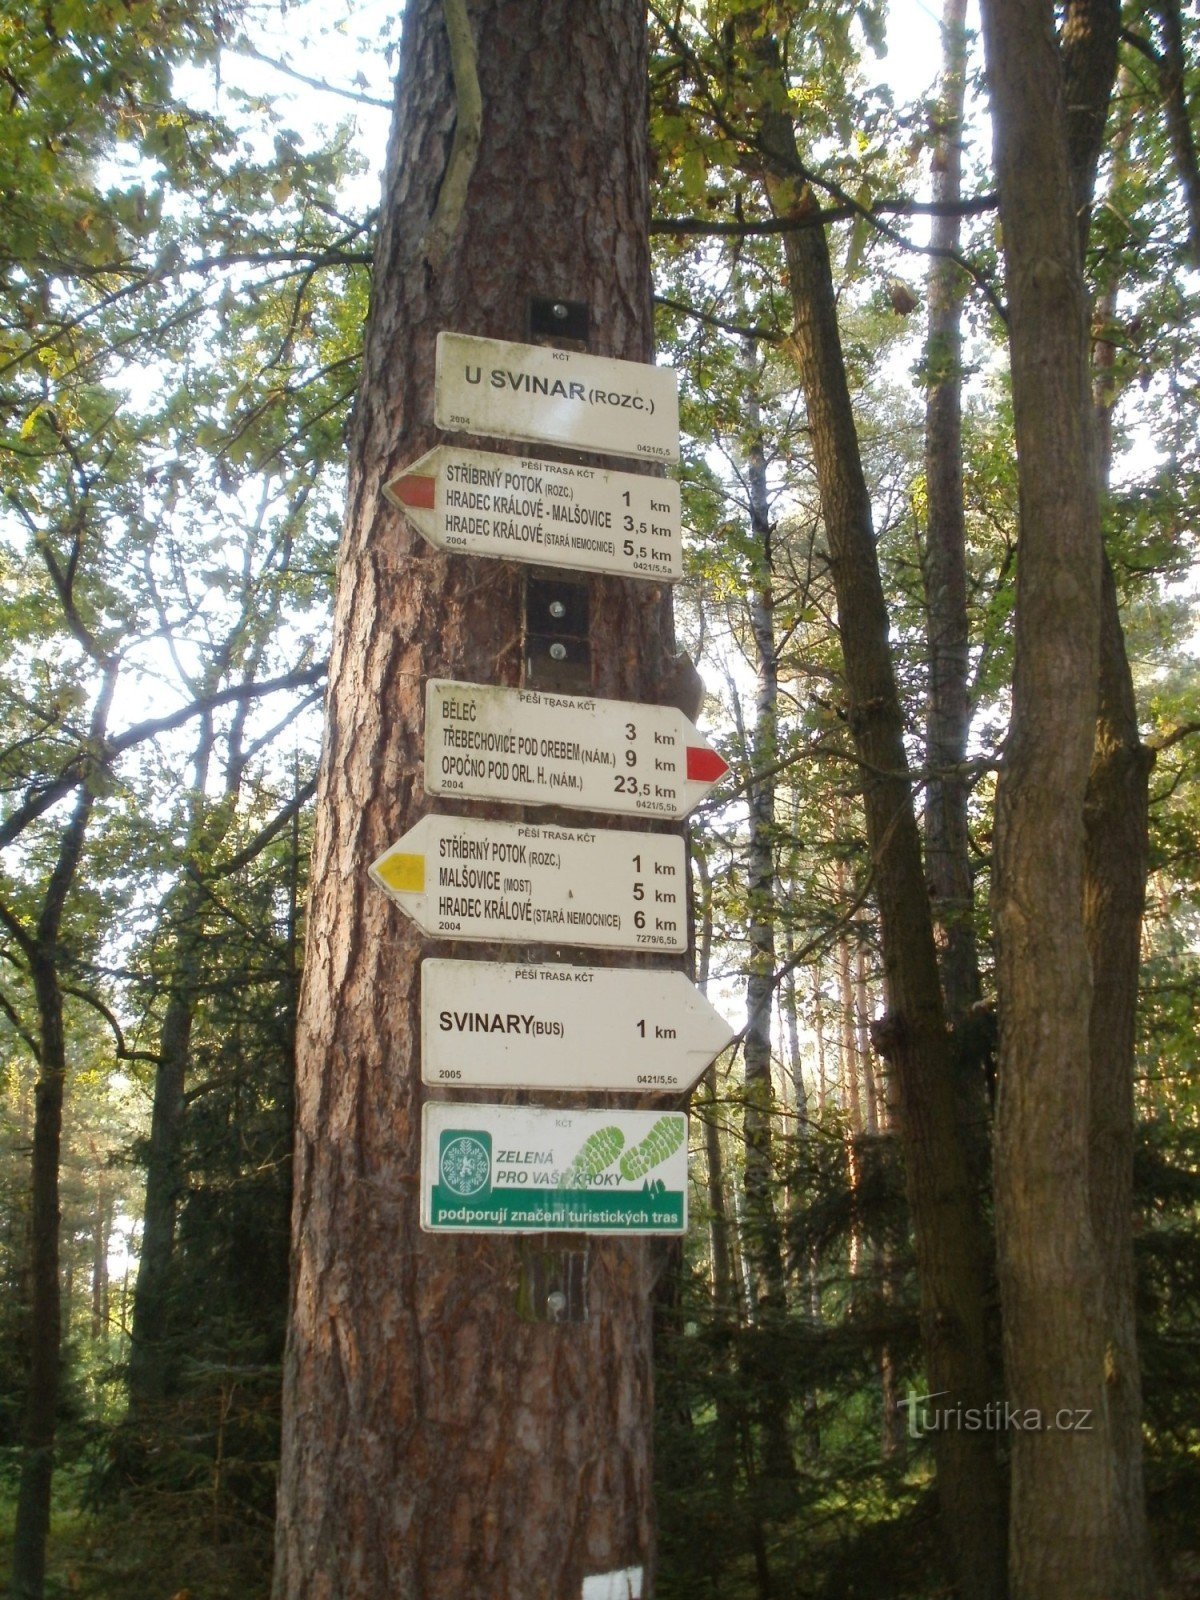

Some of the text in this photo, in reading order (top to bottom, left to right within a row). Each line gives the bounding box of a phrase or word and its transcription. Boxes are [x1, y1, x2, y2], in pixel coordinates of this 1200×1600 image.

[552, 352, 569, 362] KČT
[465, 365, 481, 385] U
[544, 464, 575, 476] TRASA
[576, 469, 595, 479] KČT
[446, 463, 671, 513] STŘÍBRNÝ POTOK (ROZC.) 1 km
[446, 489, 491, 511] HRADEC
[493, 494, 543, 519] KRÁLOVÉ
[552, 504, 612, 529] MALŠOVICE
[623, 515, 648, 535] 3,5
[651, 524, 672, 538] km
[445, 514, 490, 536] HRADEC
[571, 537, 615, 556] NEMOCNICE)
[623, 540, 648, 559] 5,5
[651, 548, 672, 562] km
[446, 535, 467, 546] 2004
[543, 697, 575, 709] TRASA
[577, 700, 596, 711] KČT
[442, 697, 675, 746] BĚLEČ 3 km
[443, 724, 516, 754] TŘEBECHOVICE
[518, 736, 539, 756] POD
[625, 750, 637, 767] 9
[655, 758, 676, 772] km
[441, 753, 676, 798] OPOČNO POD ORL. H. (NÁM.) 23,5 km
[441, 780, 464, 789] 2004
[518, 828, 596, 843] PĚŠÍ TRASA KČT
[440, 834, 676, 876] STŘÍBRNÝ POTOK (ROZC.) 1 km
[439, 865, 676, 903] MALŠOVICE (MOST) 5 km
[439, 896, 482, 918] HRADEC
[567, 911, 621, 931] NEMOCNICE)
[633, 910, 646, 929] 6
[655, 917, 677, 931] km
[438, 921, 461, 931] 2004
[636, 934, 677, 945] 7279/6,5b
[515, 969, 594, 983] PĚŠÍ TRASA KČT
[636, 1019, 646, 1038] 1
[655, 1026, 677, 1039] km
[439, 1069, 462, 1079] 2005
[637, 1075, 678, 1085] 0421/5,5c
[496, 1148, 554, 1164] ZELENÁ
[496, 1170, 528, 1184] PRO
[438, 1206, 678, 1226] podporují značení turistických tras
